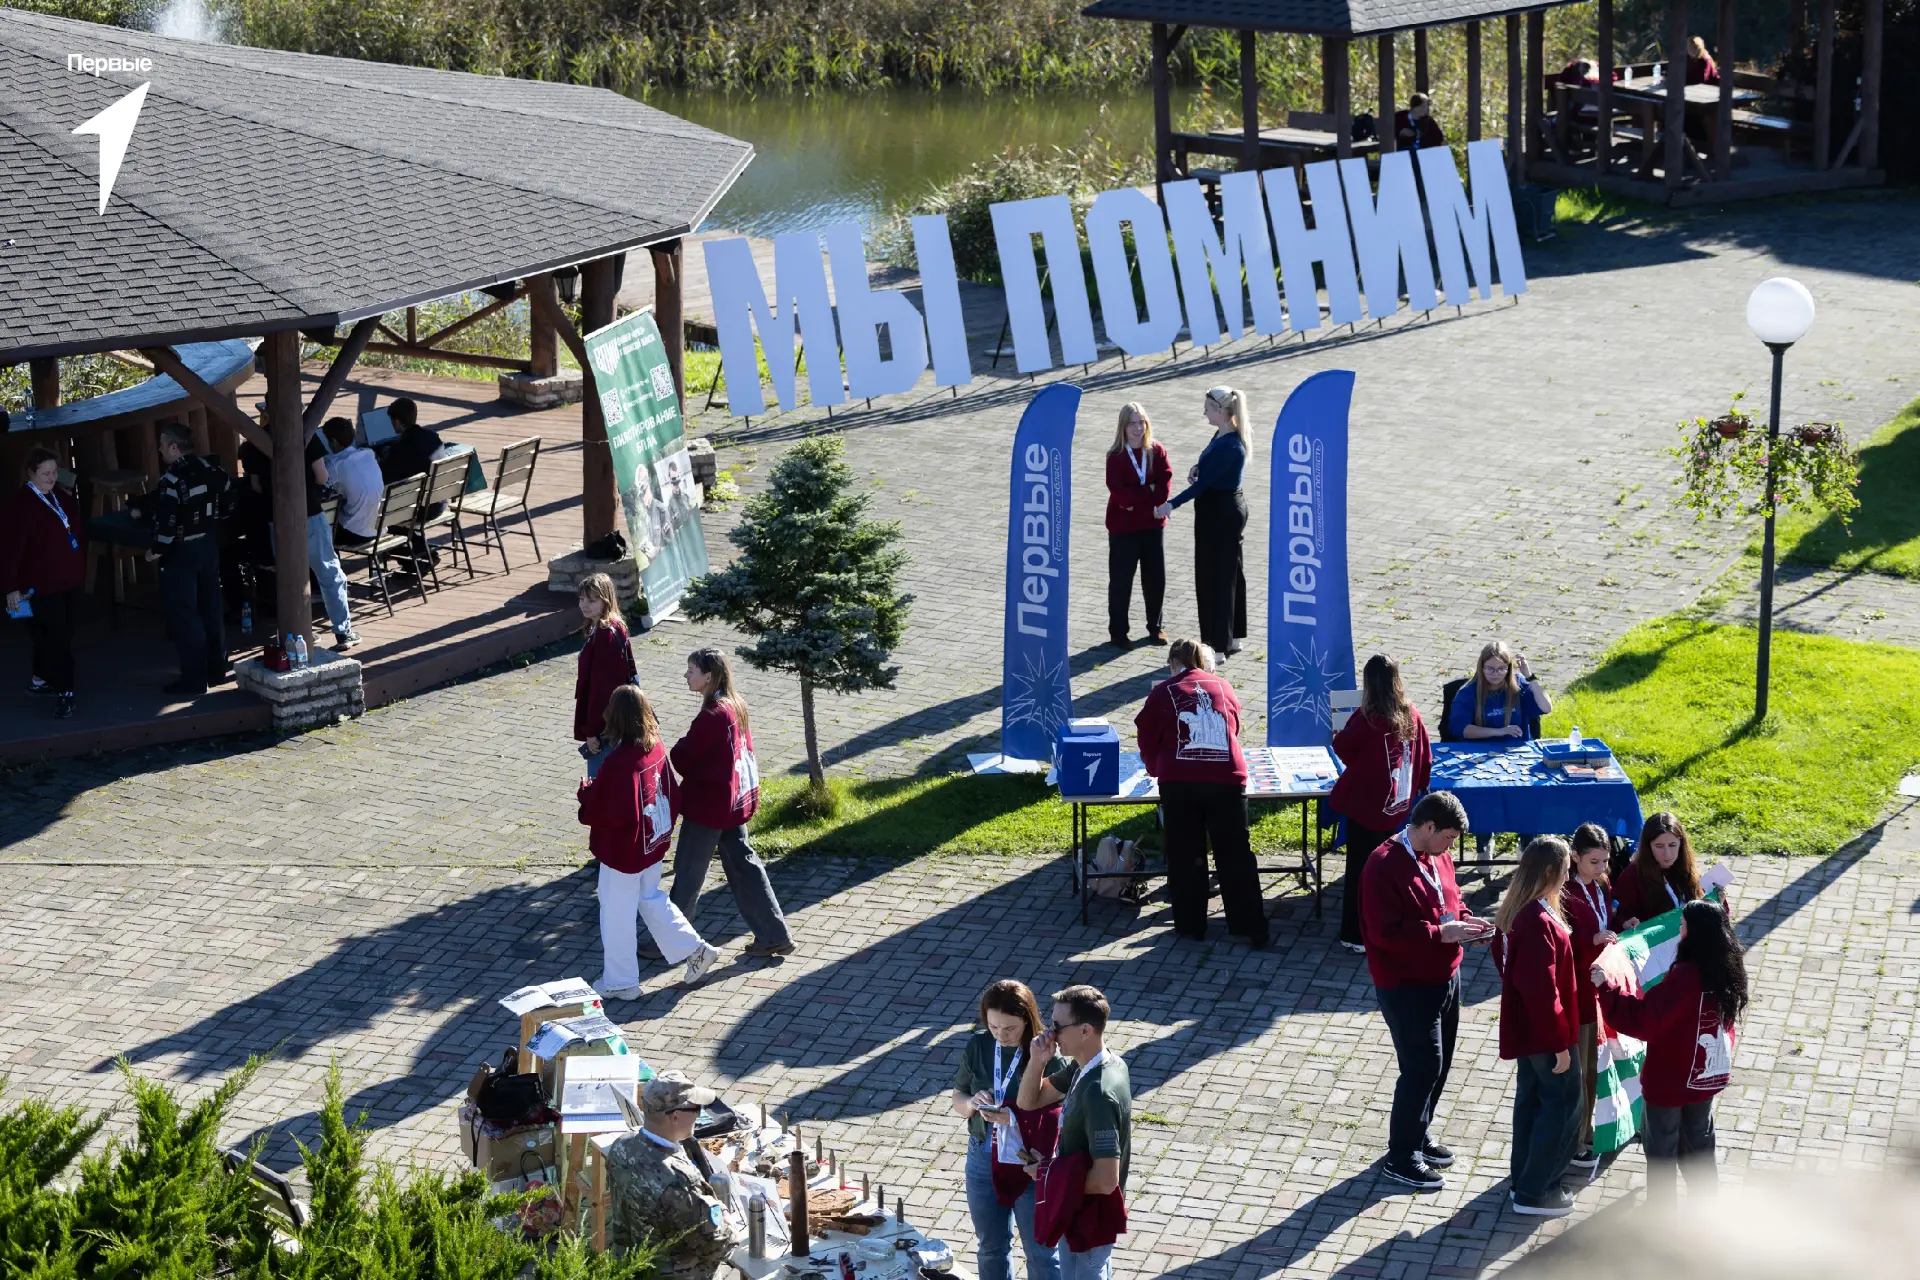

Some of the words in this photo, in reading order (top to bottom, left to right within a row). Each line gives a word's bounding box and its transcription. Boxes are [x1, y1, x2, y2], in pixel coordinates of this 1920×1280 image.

[703, 214, 971, 417] МЫ
[989, 138, 1527, 374] ПОМНИМ
[1017, 444, 1059, 638] Первые
[1052, 454, 1061, 497] область
[1052, 498, 1062, 557] Псковская
[1284, 434, 1321, 626] Первые
